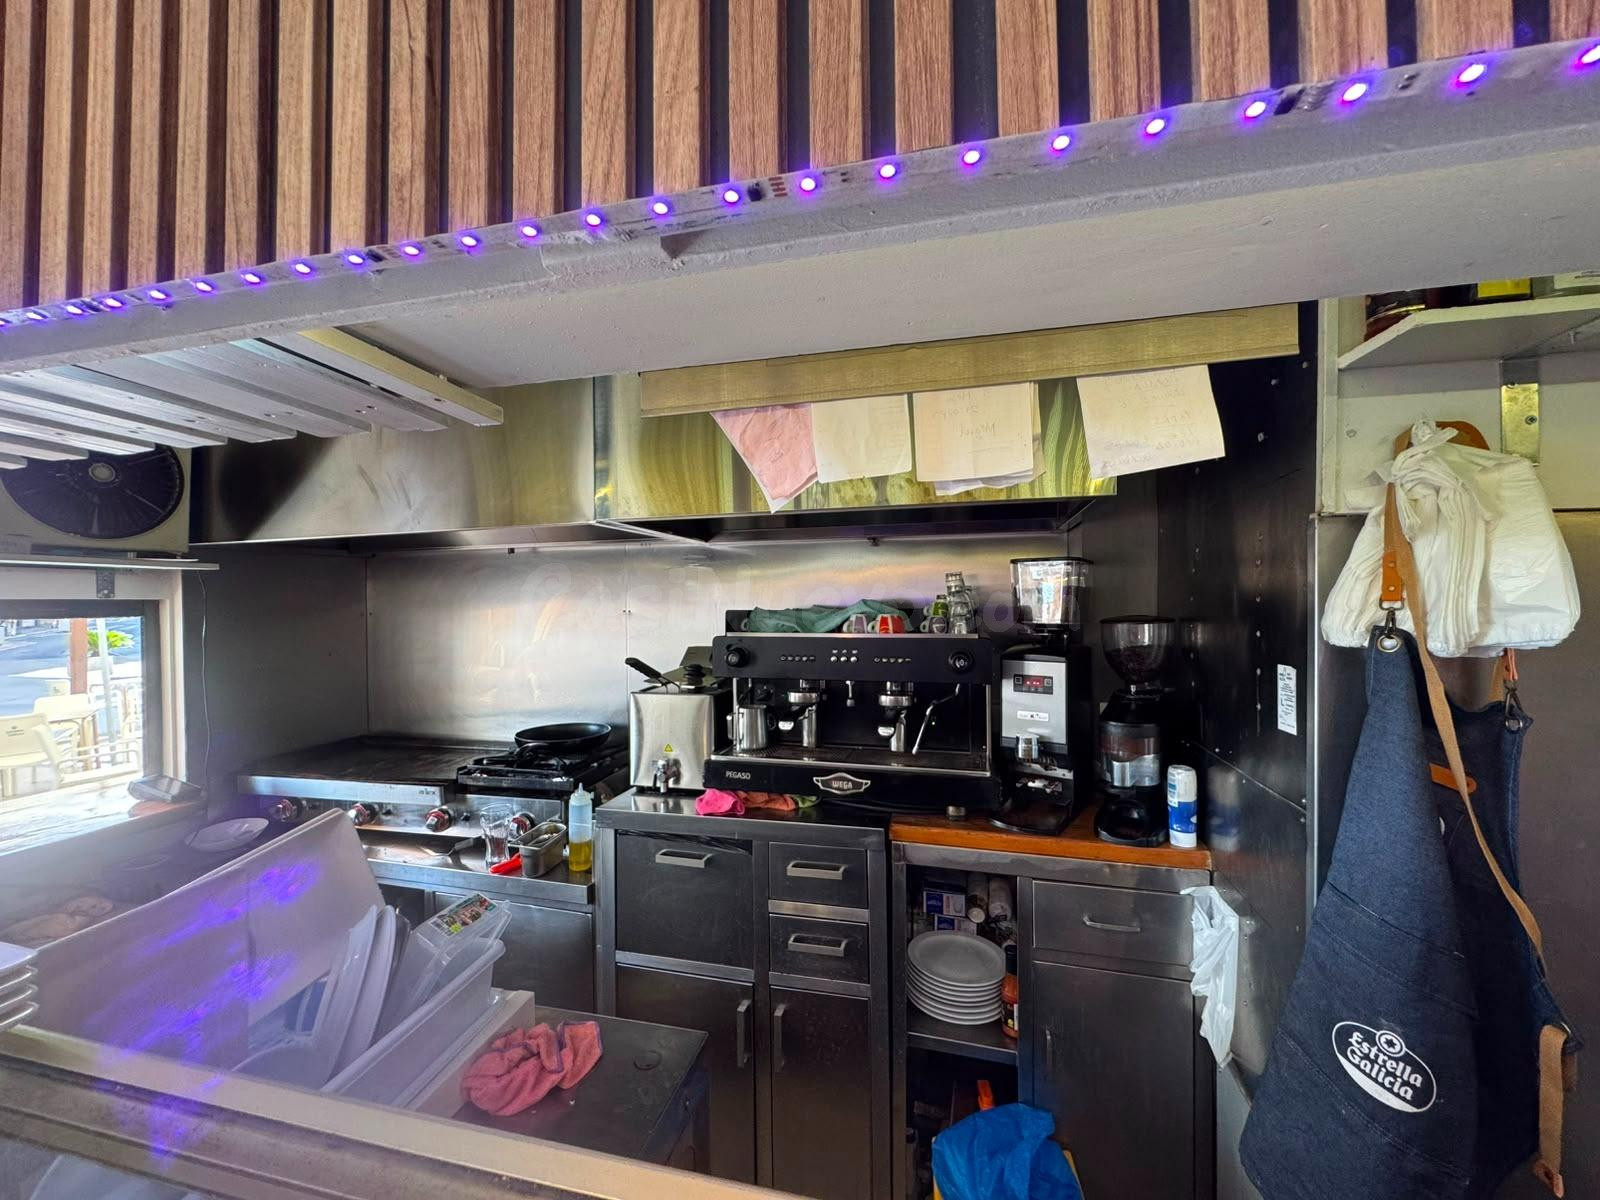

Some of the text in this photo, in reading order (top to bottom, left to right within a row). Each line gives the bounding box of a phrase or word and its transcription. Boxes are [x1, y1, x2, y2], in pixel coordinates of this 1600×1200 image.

[725, 770, 751, 780] PEGASO
[831, 780, 853, 790] WEGA
[1346, 1046, 1414, 1101] Galicia
[1347, 1031, 1423, 1088] Estrella
